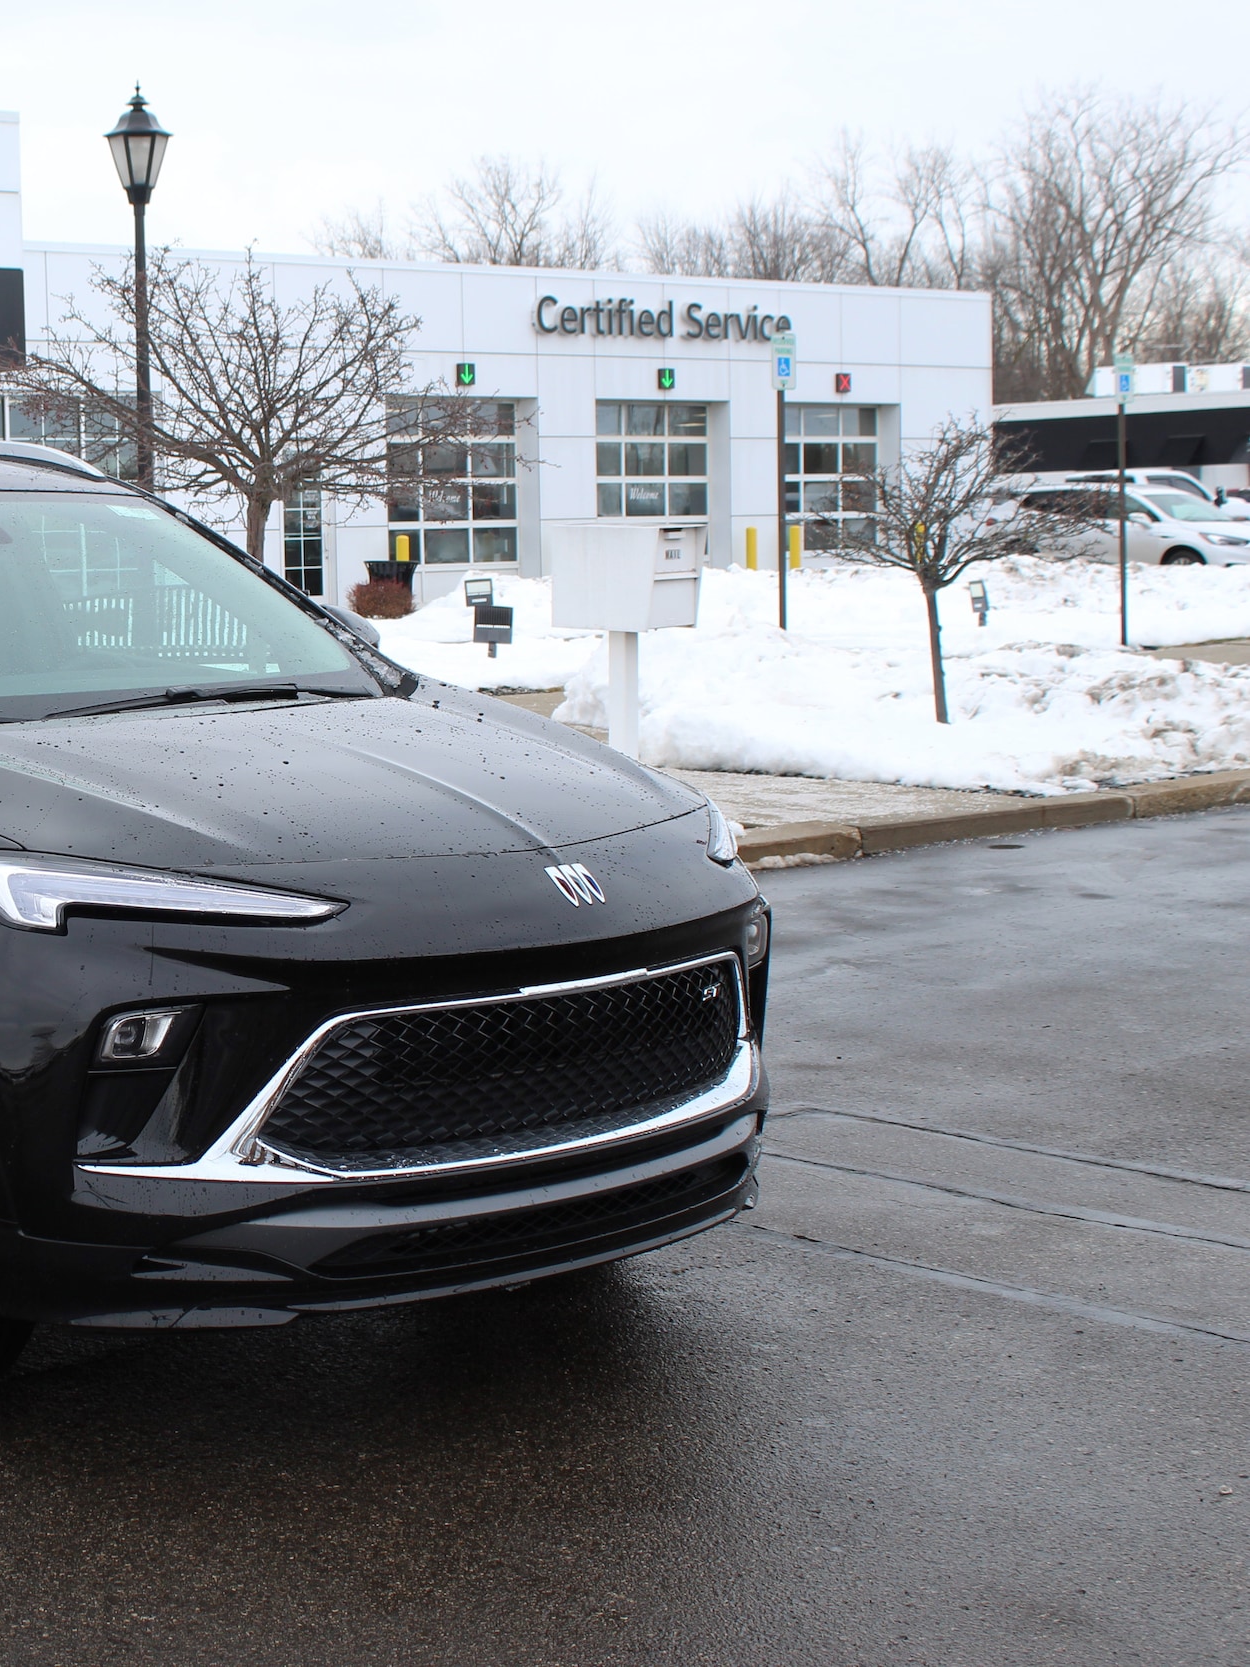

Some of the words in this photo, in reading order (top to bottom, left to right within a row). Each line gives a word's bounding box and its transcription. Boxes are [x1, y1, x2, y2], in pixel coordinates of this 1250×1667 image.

[533, 294, 675, 338] Certified
[684, 302, 792, 342] Service
[629, 487, 660, 501] Welcome
